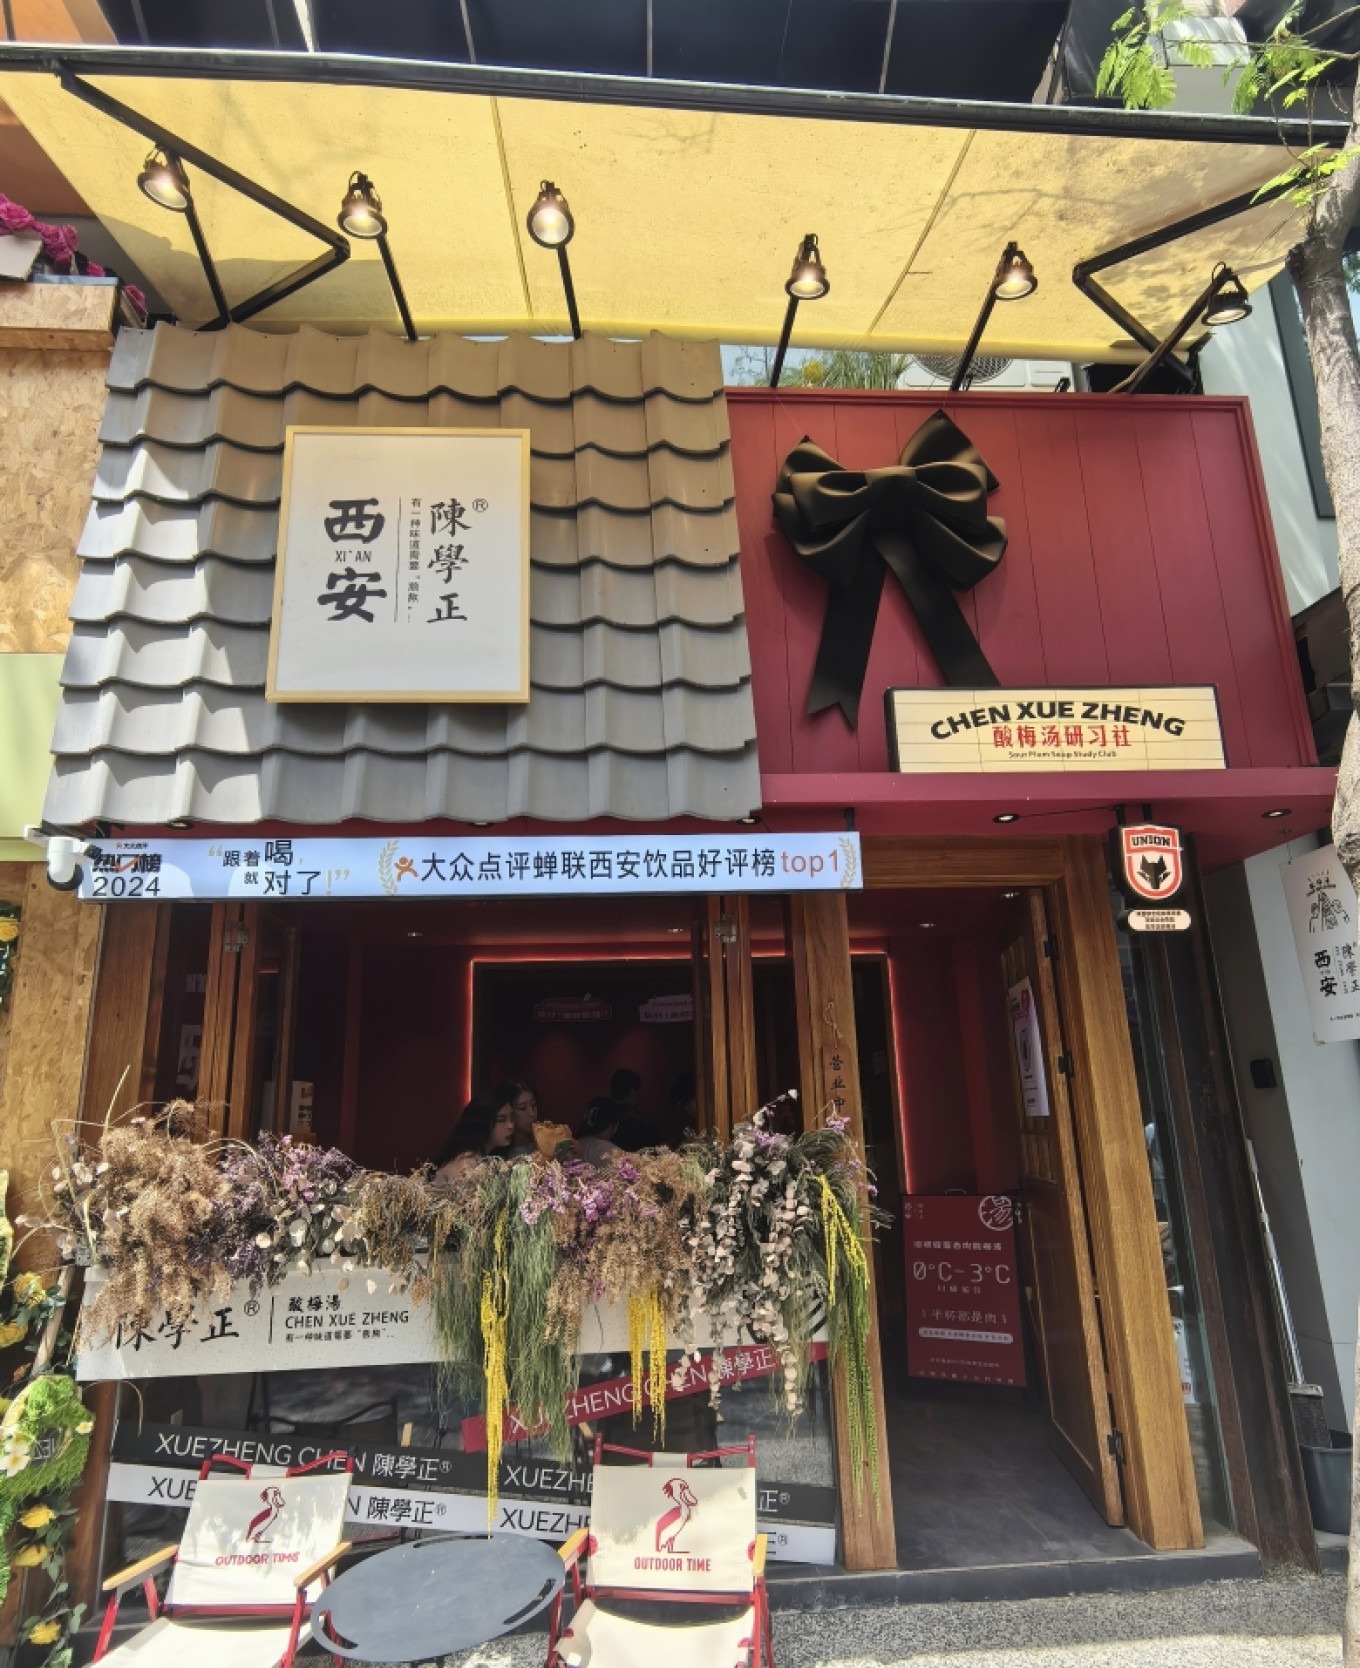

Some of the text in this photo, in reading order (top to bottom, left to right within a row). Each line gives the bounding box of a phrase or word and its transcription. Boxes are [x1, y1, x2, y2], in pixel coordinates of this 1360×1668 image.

[317, 497, 387, 623] 西安
[930, 701, 1186, 740] CHEN XUE ZHENG
[992, 724, 1132, 748] 酸梅汤研习社
[1131, 835, 1171, 847] UNION
[92, 876, 161, 897] 2024
[1314, 949, 1338, 998] 西安
[829, 1054, 847, 1113] 营业中
[285, 1310, 409, 1329] CHEN XUE ZHENG
[155, 1432, 293, 1466] XUEZHENG
[215, 1551, 299, 1567] OUTDOOR TIME
[634, 1556, 711, 1572] OUTDOOR TIME
